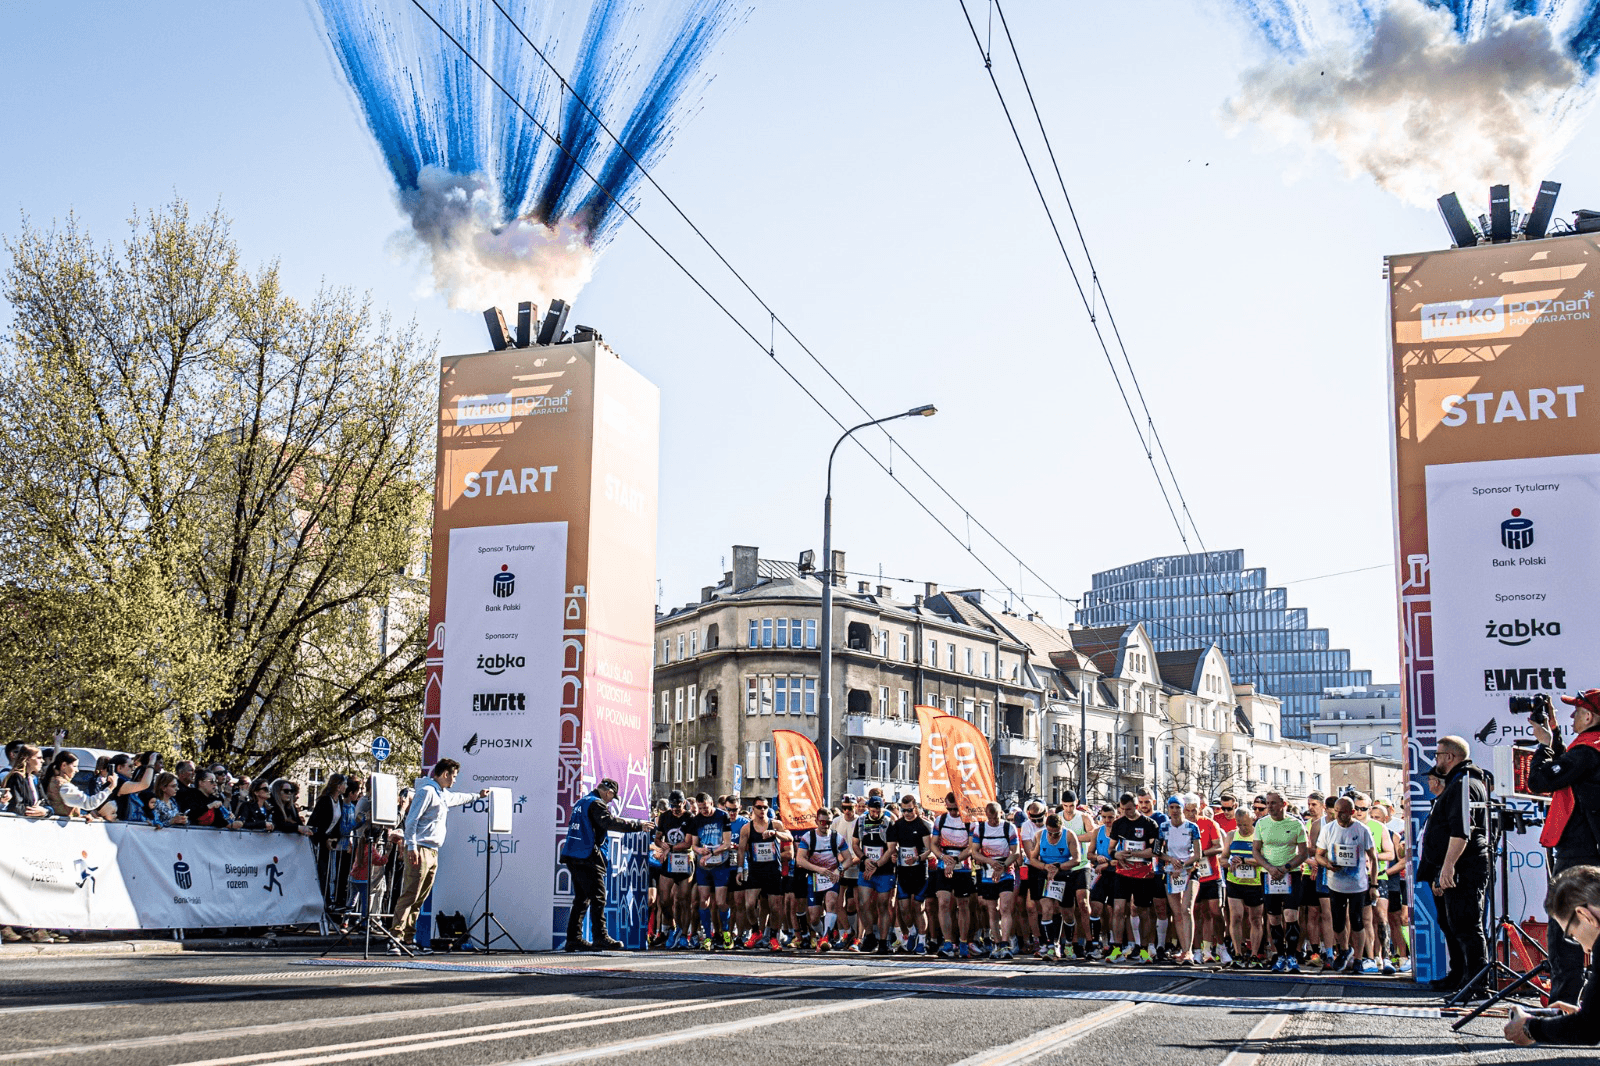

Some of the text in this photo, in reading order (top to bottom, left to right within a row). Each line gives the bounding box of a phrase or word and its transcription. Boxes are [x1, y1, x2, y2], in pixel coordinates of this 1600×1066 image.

[1509, 311, 1591, 326] PÓŁMARATON
[1441, 384, 1585, 427] START
[463, 465, 559, 499] START
[1472, 482, 1560, 496] Sponsor Tytularny
[604, 473, 645, 516] START
[477, 543, 536, 555] Sponsor Tytularny
[1492, 556, 1547, 567] Bank Polski
[1494, 592, 1547, 603] Sponsorzy
[485, 603, 521, 612] Bank Polski
[1485, 618, 1561, 638] żabka
[485, 632, 519, 641] Sponsorzy
[476, 653, 526, 670] żabka
[1494, 667, 1567, 691] Witt
[480, 693, 526, 711] Witt
[596, 705, 641, 730] W POZNANIU
[472, 774, 519, 782] Organizatorzy
[1338, 851, 1354, 859] 8812
[225, 863, 259, 877] Biegajmy
[227, 880, 249, 889] razem
